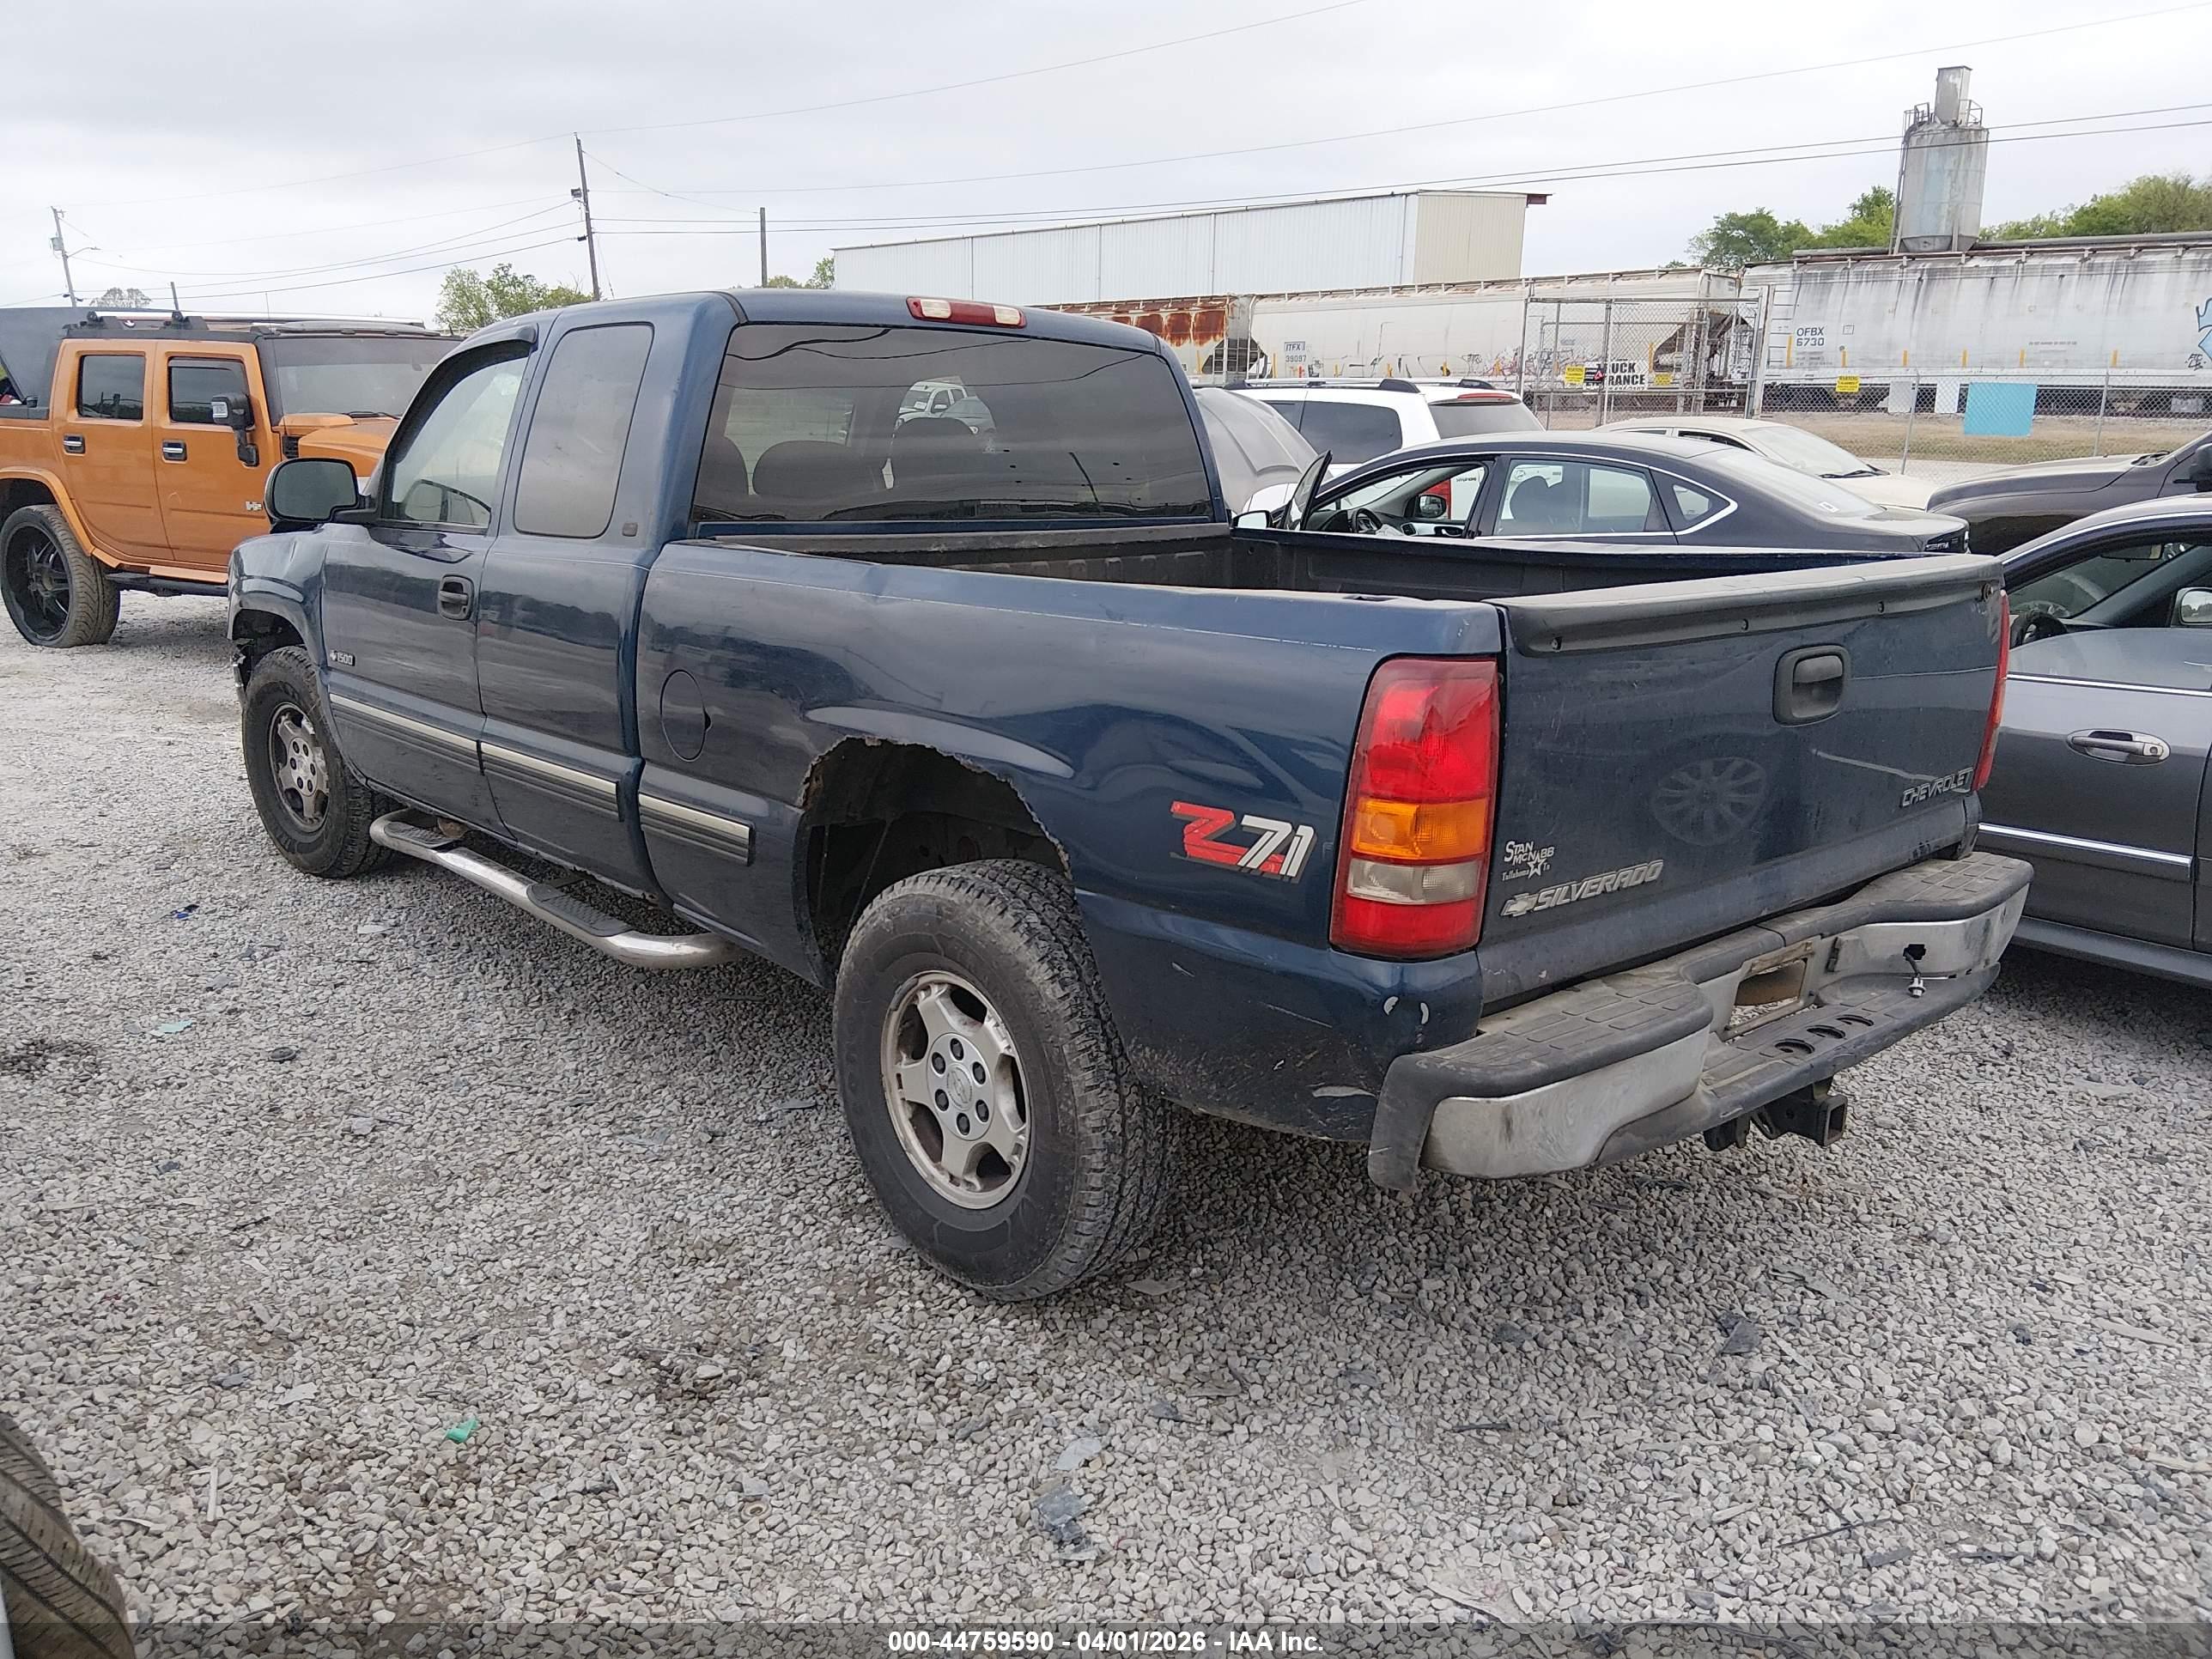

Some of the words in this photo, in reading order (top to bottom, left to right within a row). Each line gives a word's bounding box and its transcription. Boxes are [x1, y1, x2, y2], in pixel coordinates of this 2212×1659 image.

[1796, 327, 1825, 337] OFBX
[1796, 337, 1825, 347] 6730
[1902, 767, 1974, 807] CHEVROLET
[1170, 800, 1317, 883] Z71
[1504, 841, 1534, 862] STAN
[1534, 860, 1663, 911] SILVERADO
